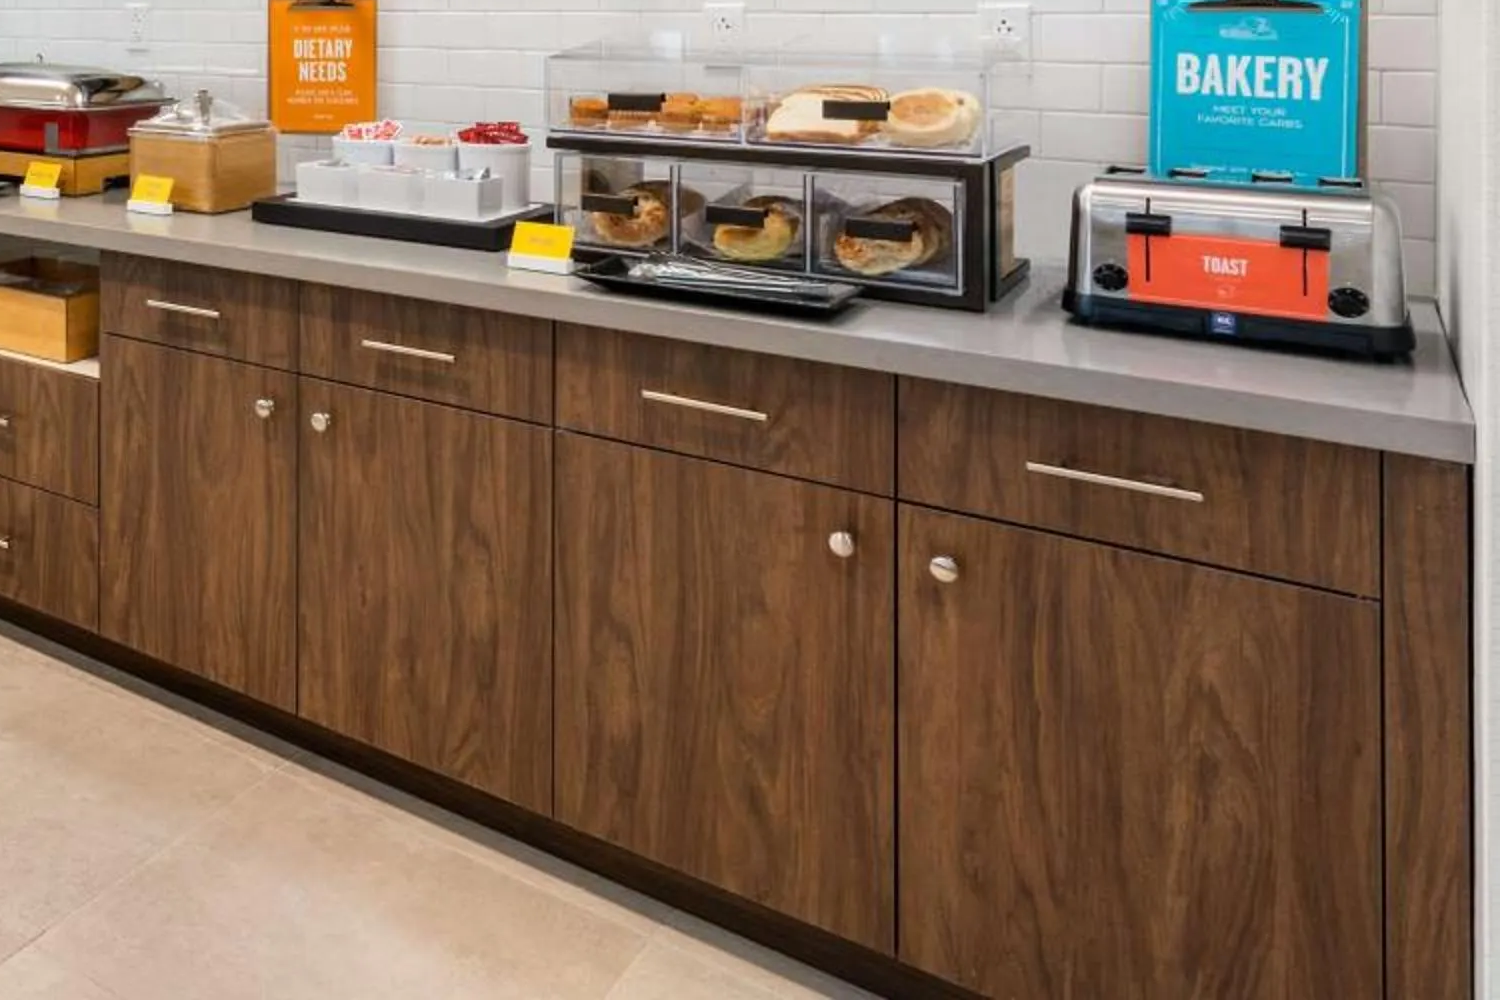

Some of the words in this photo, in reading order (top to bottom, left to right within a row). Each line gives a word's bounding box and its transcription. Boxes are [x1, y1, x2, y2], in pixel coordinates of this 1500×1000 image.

[293, 38, 353, 60] DIETARY
[298, 61, 347, 82] NEEDS
[1176, 52, 1329, 101] BAKERY
[1197, 112, 1254, 126] FAVORITE
[1258, 118, 1304, 129] CARBS
[1213, 105, 1246, 115] MEET
[1251, 107, 1285, 117] YOUR
[1202, 254, 1248, 278] TOAST
